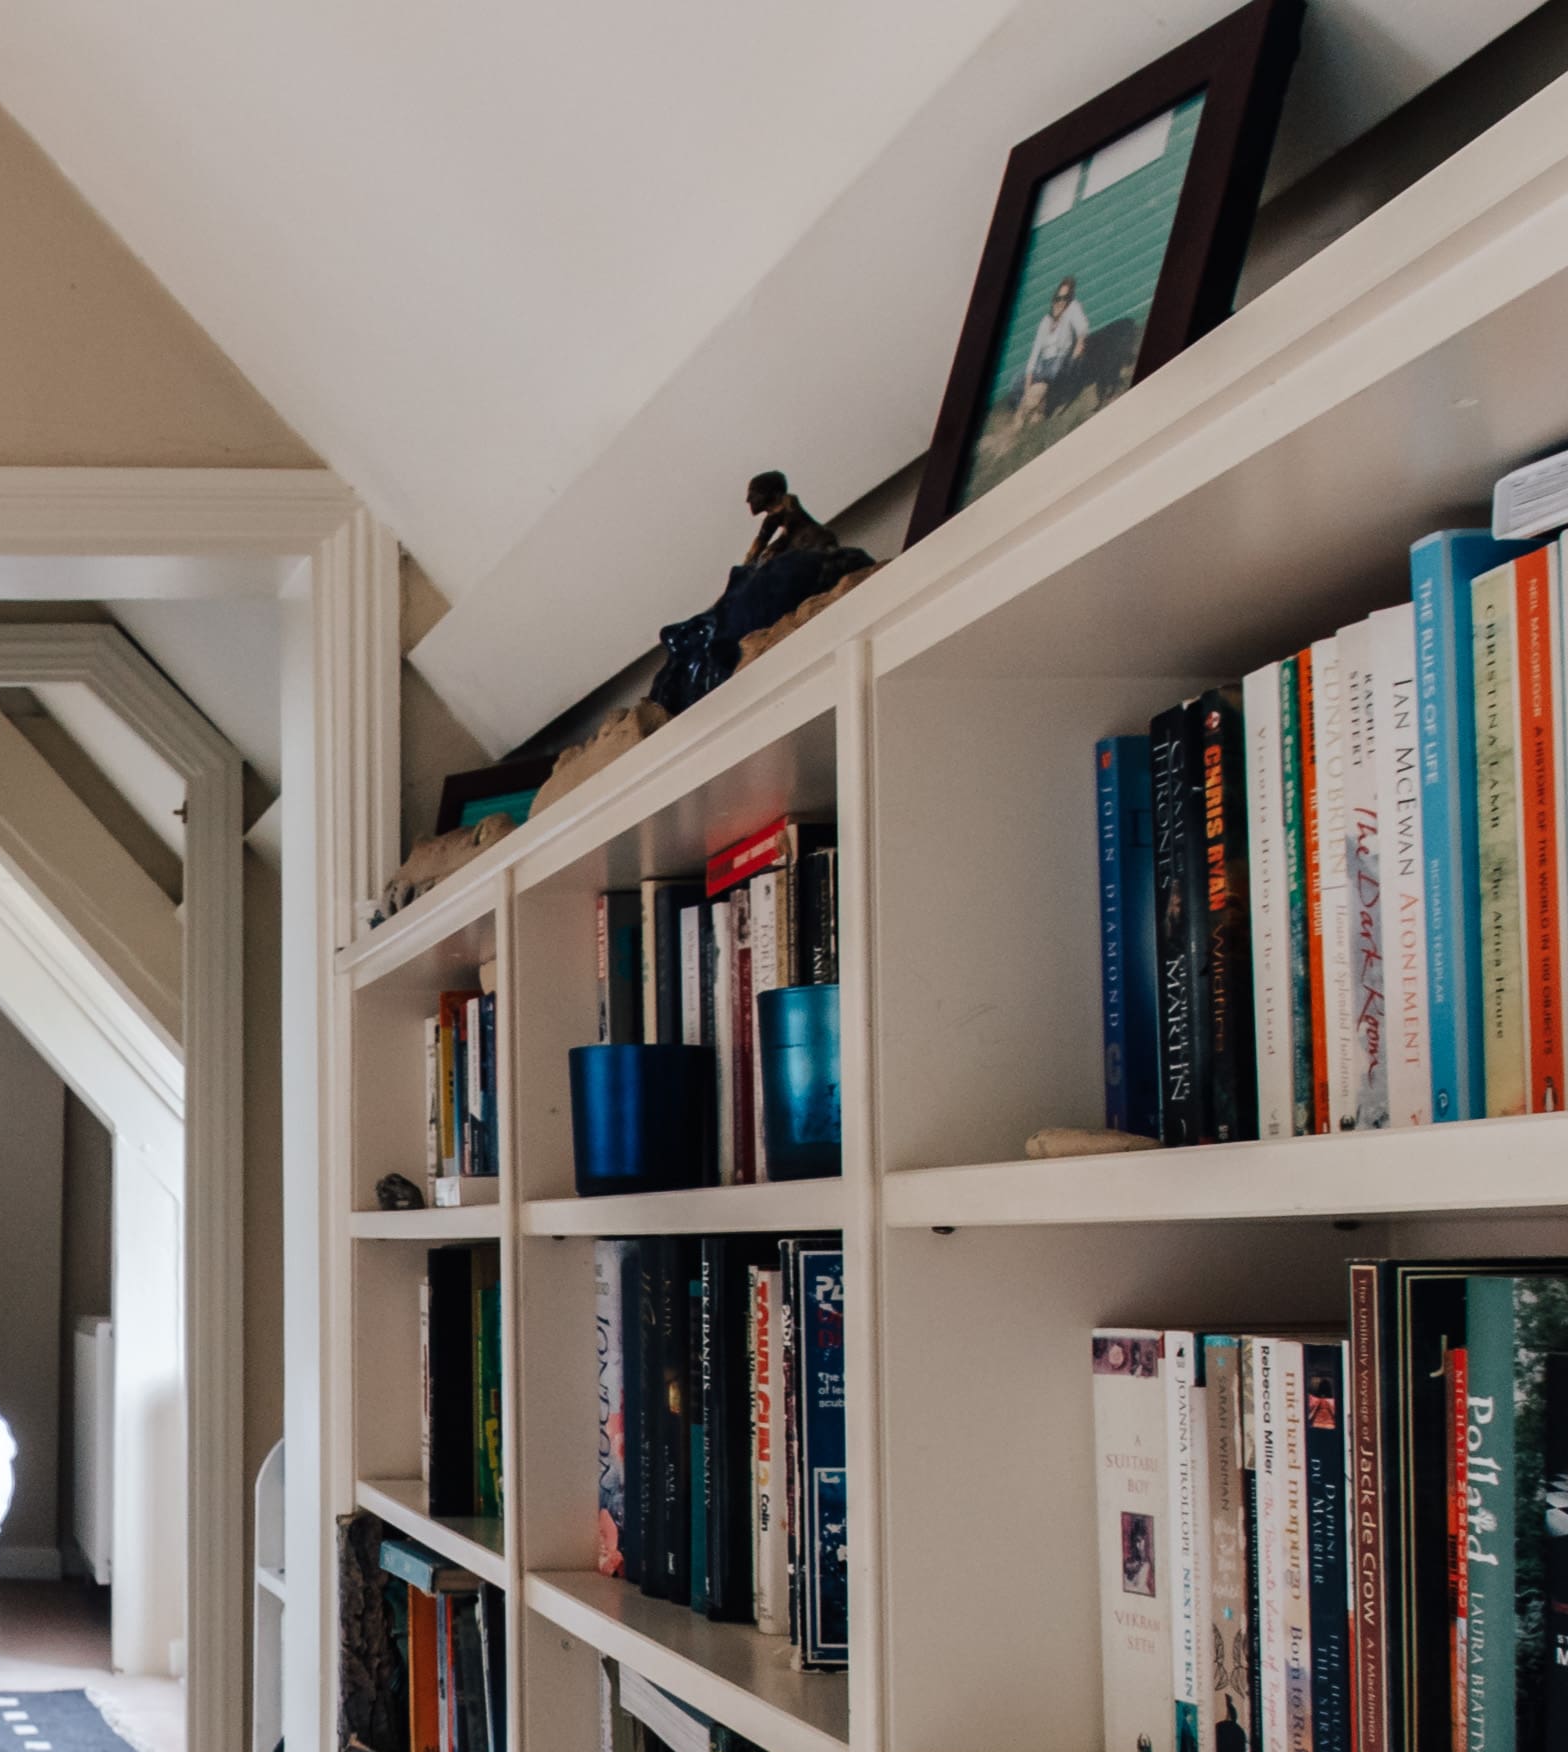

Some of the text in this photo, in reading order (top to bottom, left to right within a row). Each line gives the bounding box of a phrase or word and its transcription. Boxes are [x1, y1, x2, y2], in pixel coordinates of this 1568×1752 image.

[1349, 670, 1362, 768] SEIFFERT
[1364, 673, 1376, 757] RACHEL
[1416, 578, 1438, 786] THE RULES OF LIFE
[1204, 745, 1227, 912] CHRIS RYAN
[1393, 677, 1421, 1066] IAN ATONEMENT
[1485, 603, 1505, 1039] CHRISTINA LAMB The House
[1527, 578, 1553, 1056] NEIL MACGREGOR HISTORY THE 100 OBJECTS
[1105, 884, 1119, 1028] DIAMOND
[1166, 959, 1185, 1102] MARTIN
[702, 1261, 711, 1390] DICK FRANCIS
[756, 1281, 770, 1386] TOWN
[818, 1372, 840, 1382] The
[595, 1315, 611, 1494] LONDON
[1260, 1345, 1275, 1476] Rebecca Miller
[1285, 1371, 1301, 1470] michael
[761, 1493, 770, 1532] Colin
[1127, 1479, 1150, 1493] BOY
[1312, 1459, 1321, 1484] DU
[1325, 1484, 1336, 1560] DAPHNE
[1176, 1377, 1193, 1698] JOANNA TROLLOPE NEXT KIN
[1360, 1445, 1377, 1743] Jack de Crow Mackinnon
[1114, 1610, 1161, 1631] VIKRAM
[1128, 1635, 1156, 1651] SETH
[1470, 1591, 1486, 1664] LAURA
